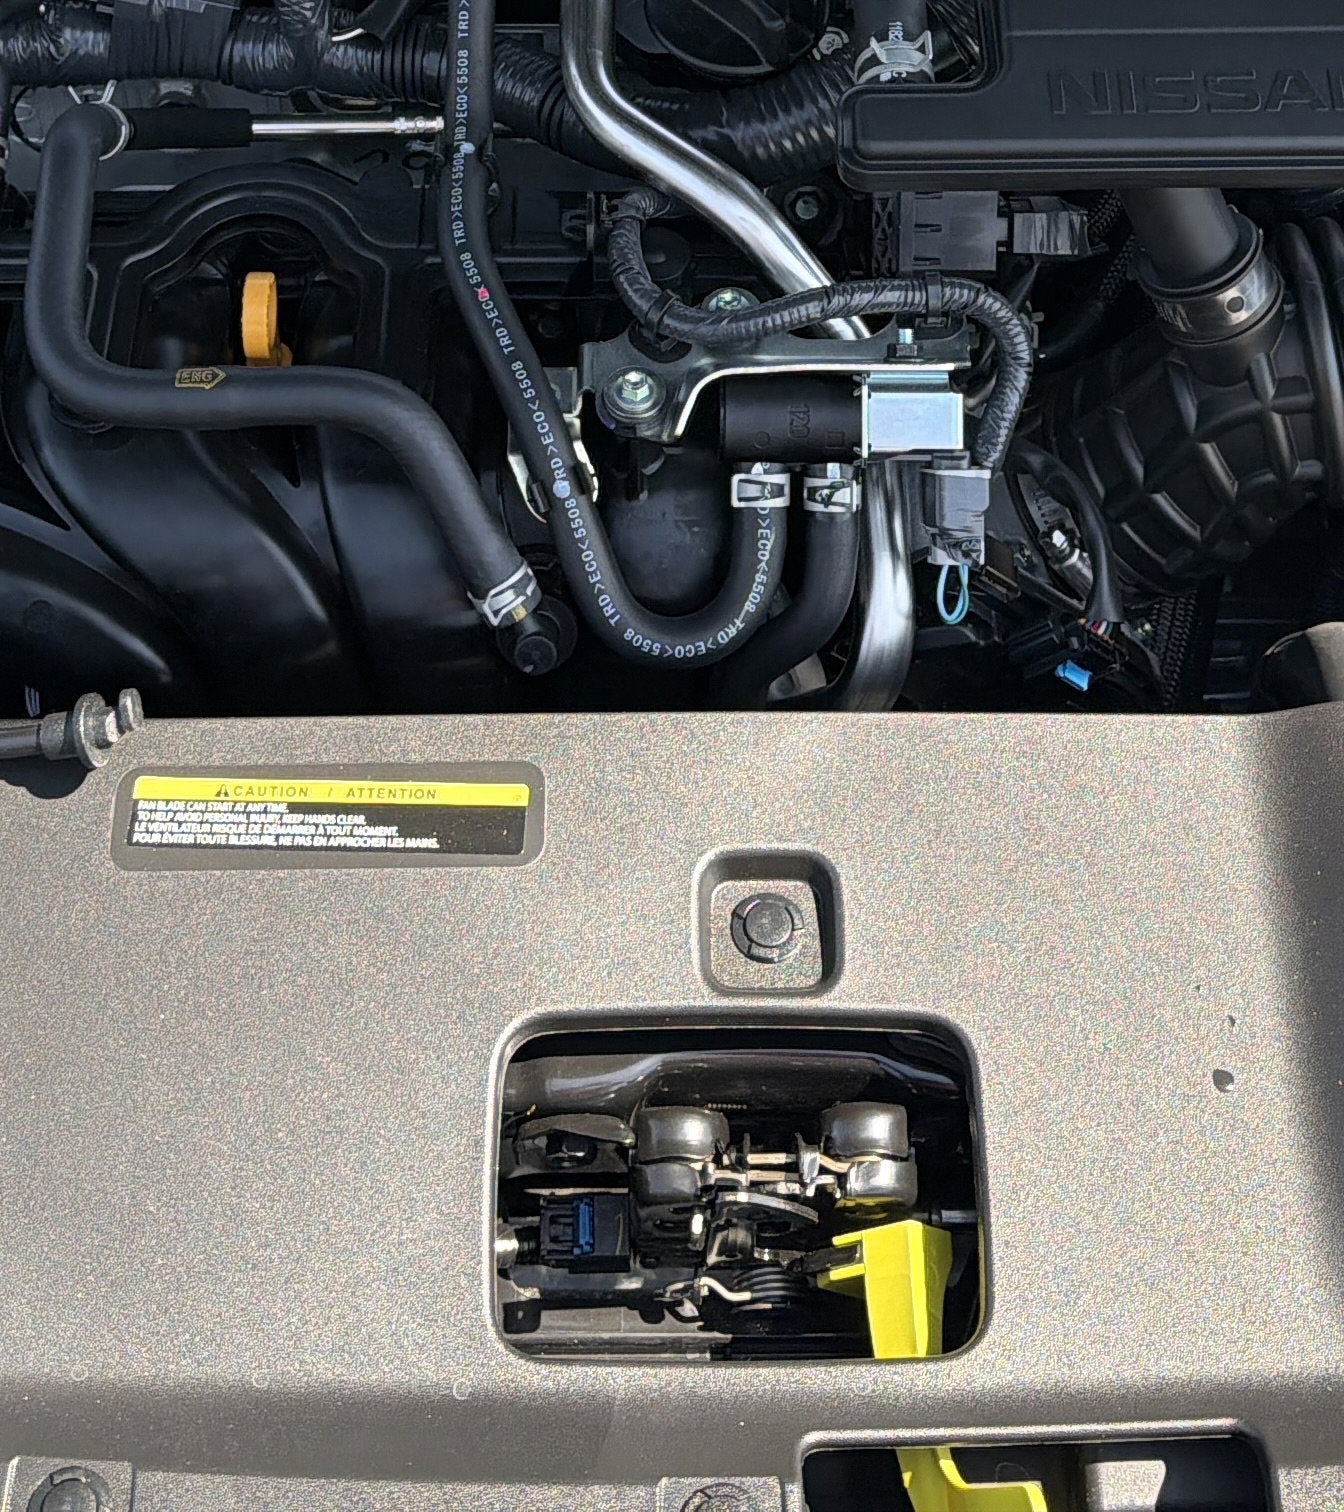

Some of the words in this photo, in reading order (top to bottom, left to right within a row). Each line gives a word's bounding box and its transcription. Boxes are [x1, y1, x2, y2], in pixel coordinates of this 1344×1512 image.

[180, 369, 213, 384] ENG
[234, 785, 308, 797] CAUTION
[346, 787, 437, 799] ATTENTION
[138, 800, 156, 810] FAN
[157, 801, 185, 811] BLADE
[186, 802, 206, 811] CAN
[207, 802, 233, 812] START
[235, 803, 246, 812] AT
[138, 811, 150, 821] TO
[151, 812, 174, 821] HELP
[174, 813, 202, 822] AVOID
[203, 813, 248, 823] PERSONAL
[282, 814, 304, 824] KEEP
[307, 814, 336, 824] HANDS
[135, 821, 147, 831] LE
[148, 822, 210, 833] VENTILATEUR
[249, 824, 263, 834] DE
[325, 826, 351, 836] TOUT
[133, 833, 160, 843] POUR
[196, 834, 227, 844] TOUTE
[279, 836, 292, 845] NE
[293, 836, 313, 846] PAS
[313, 837, 327, 847] EN
[328, 837, 387, 848] APPROCHER
[387, 838, 404, 848] LES
